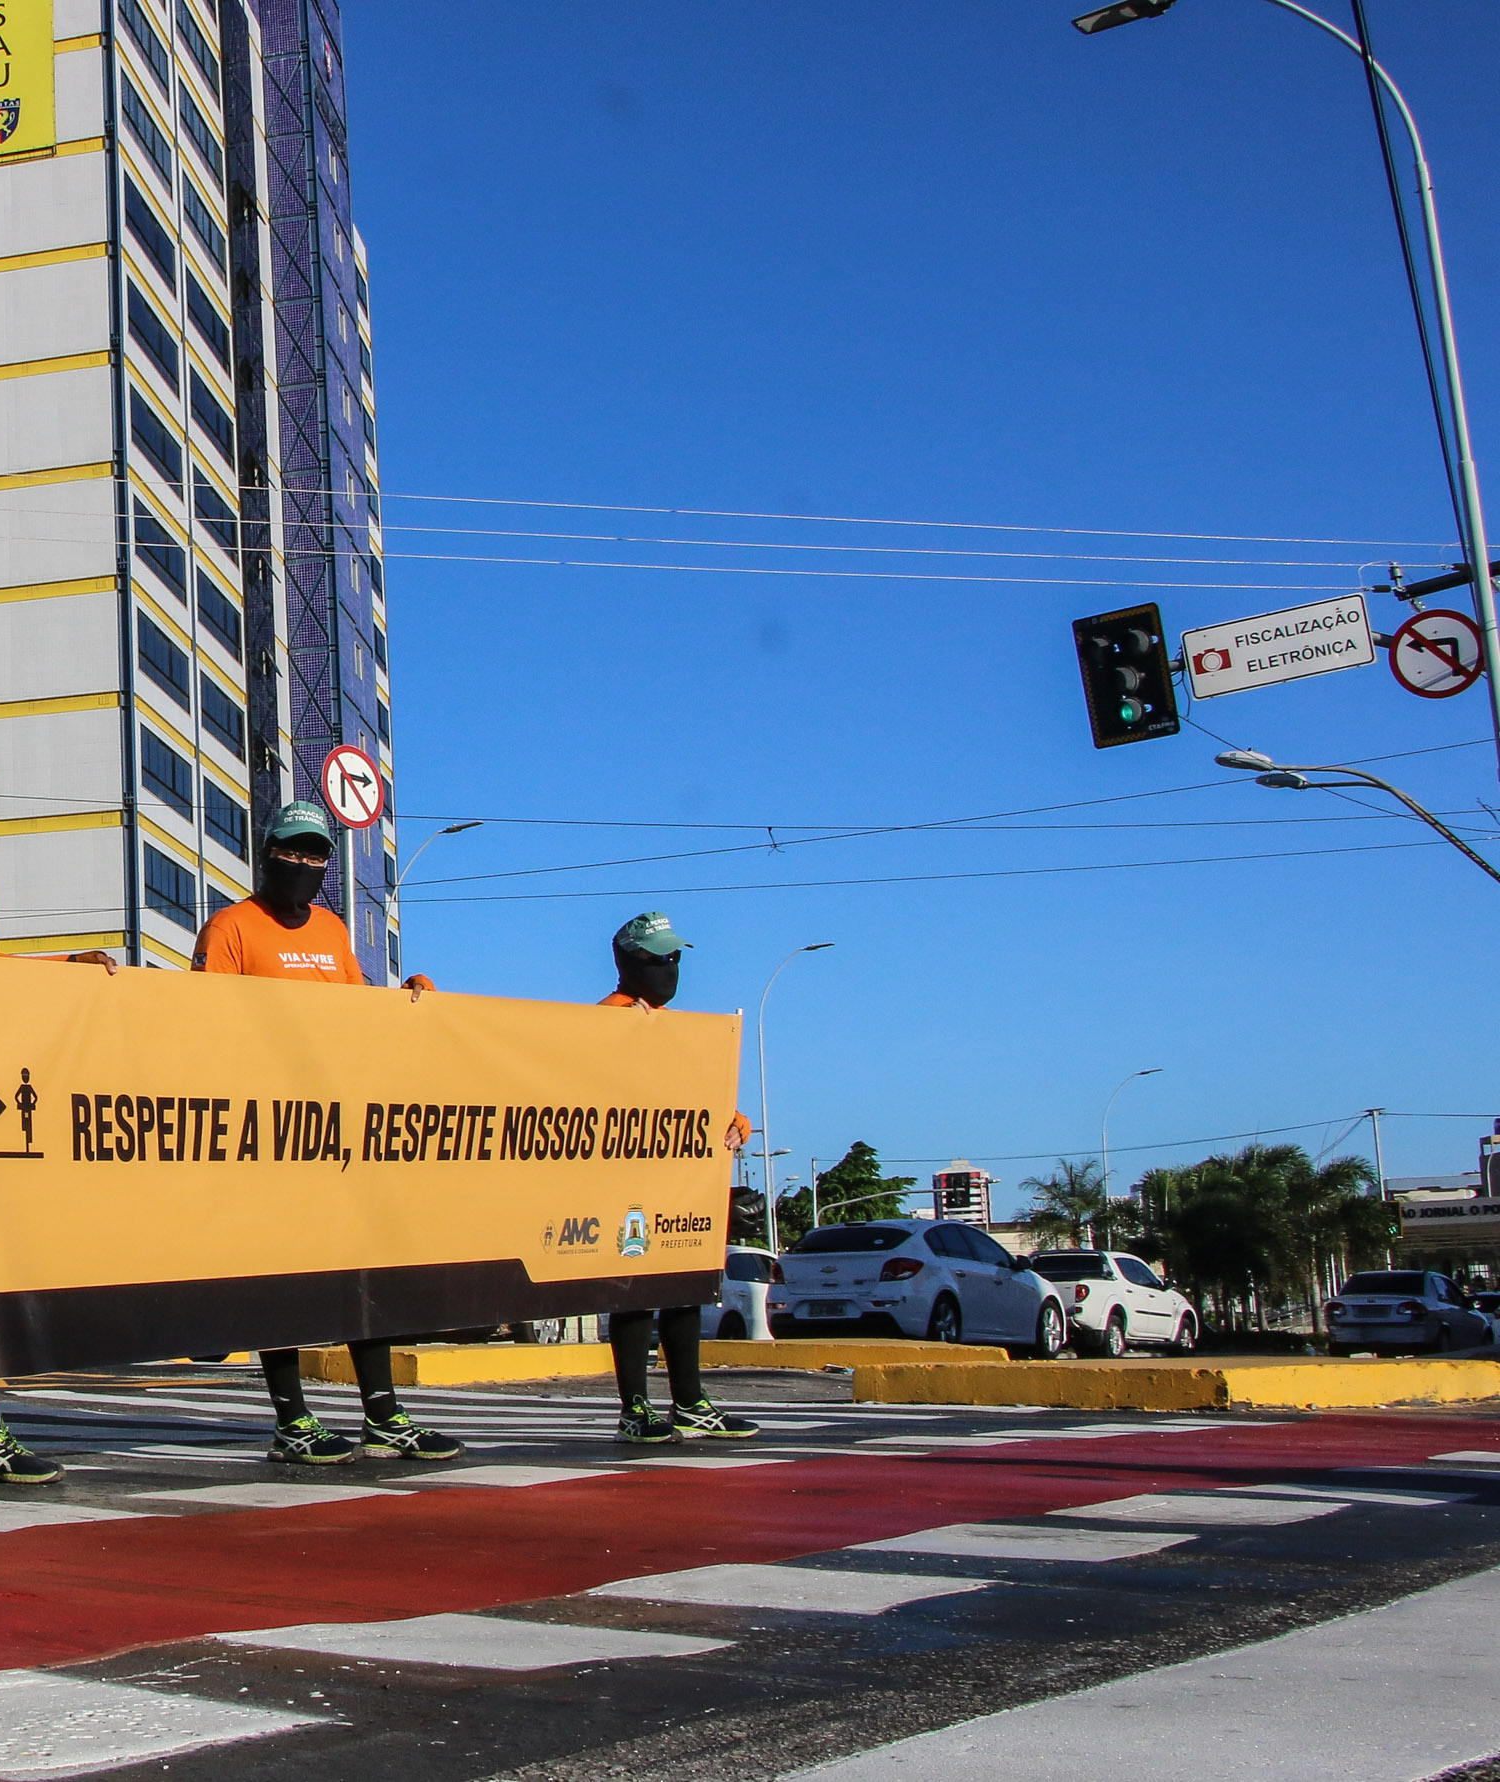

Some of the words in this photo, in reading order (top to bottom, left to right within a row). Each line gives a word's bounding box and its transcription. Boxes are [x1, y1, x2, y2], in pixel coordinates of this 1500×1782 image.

[1235, 610, 1360, 648] FISCALIZAÇÃO
[1247, 639, 1357, 672] ELETRÔNICA
[278, 953, 301, 962] VIA
[71, 1093, 230, 1163] RESPEITE
[236, 1099, 259, 1162] A
[272, 1100, 351, 1173] VIDA,
[362, 1103, 497, 1162] RESPEITE
[500, 1106, 598, 1161] NOSSOS
[601, 1107, 713, 1160] CICLISTAS.
[654, 1212, 712, 1234] Fortaleza
[1420, 1206, 1467, 1218] JORNAL
[1469, 1205, 1480, 1215] O
[557, 1217, 600, 1246] AMC
[660, 1239, 702, 1248] PREFEITURA
